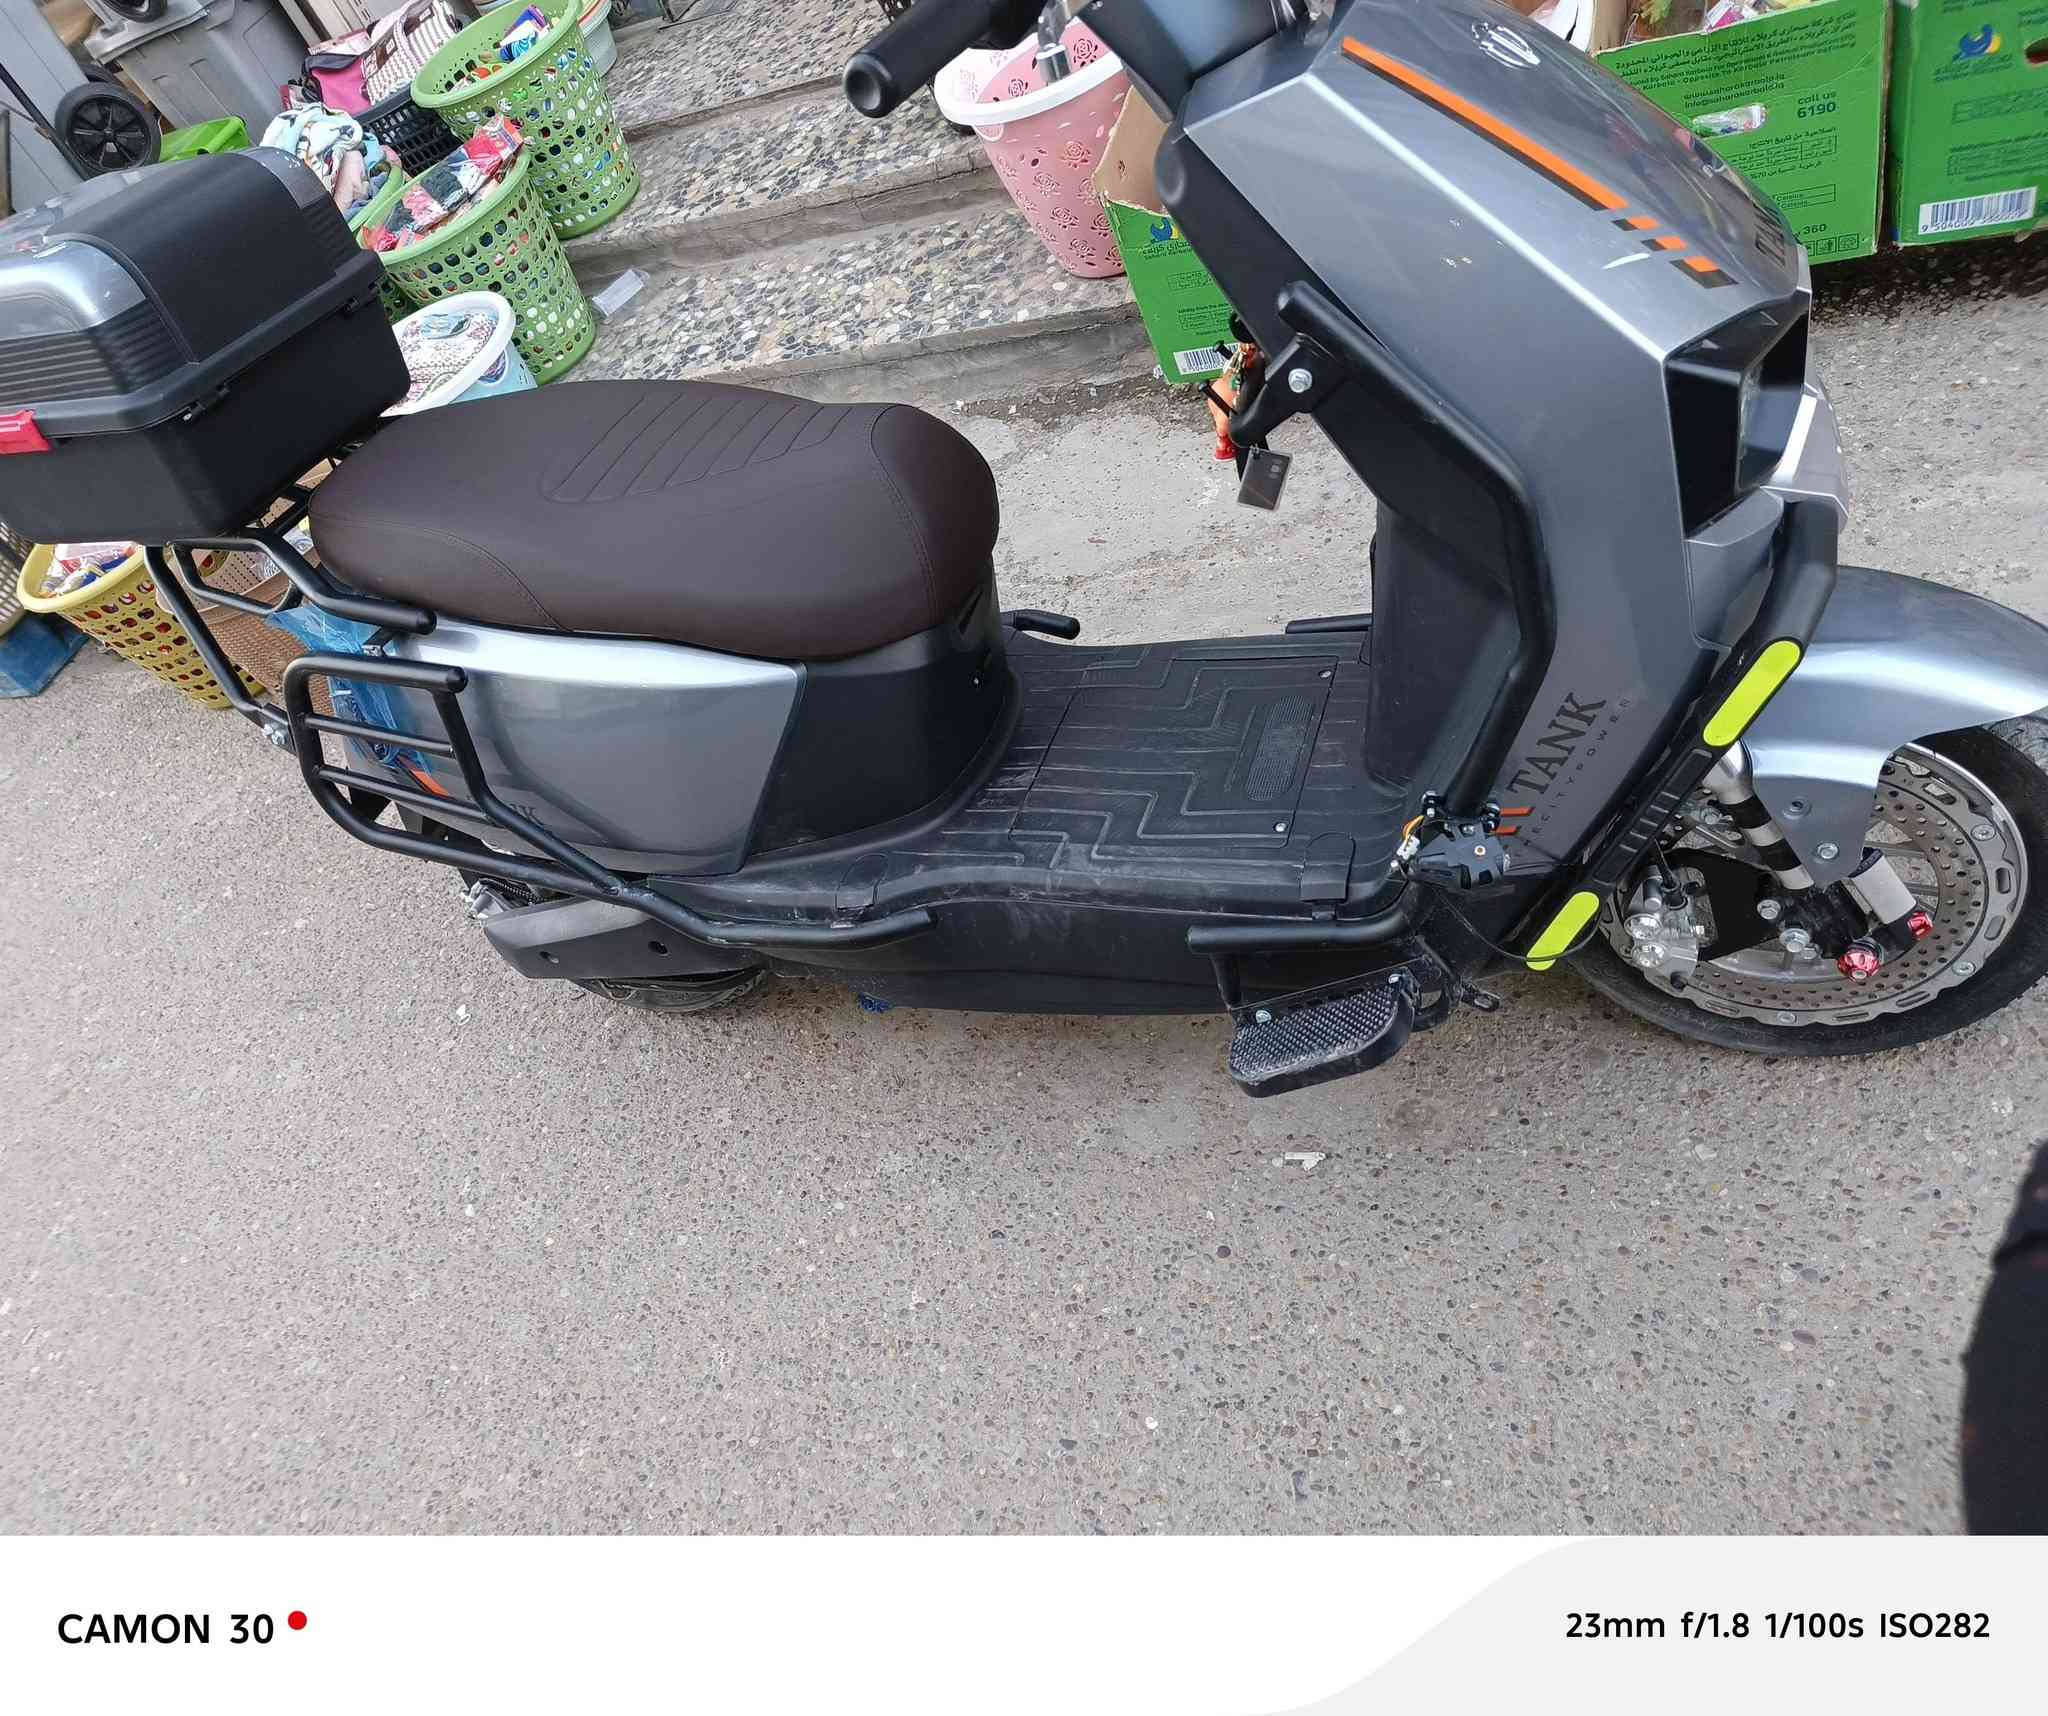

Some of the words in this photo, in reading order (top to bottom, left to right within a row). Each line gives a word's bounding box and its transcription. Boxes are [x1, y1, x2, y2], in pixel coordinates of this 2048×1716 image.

[1822, 90, 1837, 99] us
[1797, 101, 1836, 119] 6190
[1803, 223, 1827, 235] 360
[1506, 692, 1606, 794] TANK
